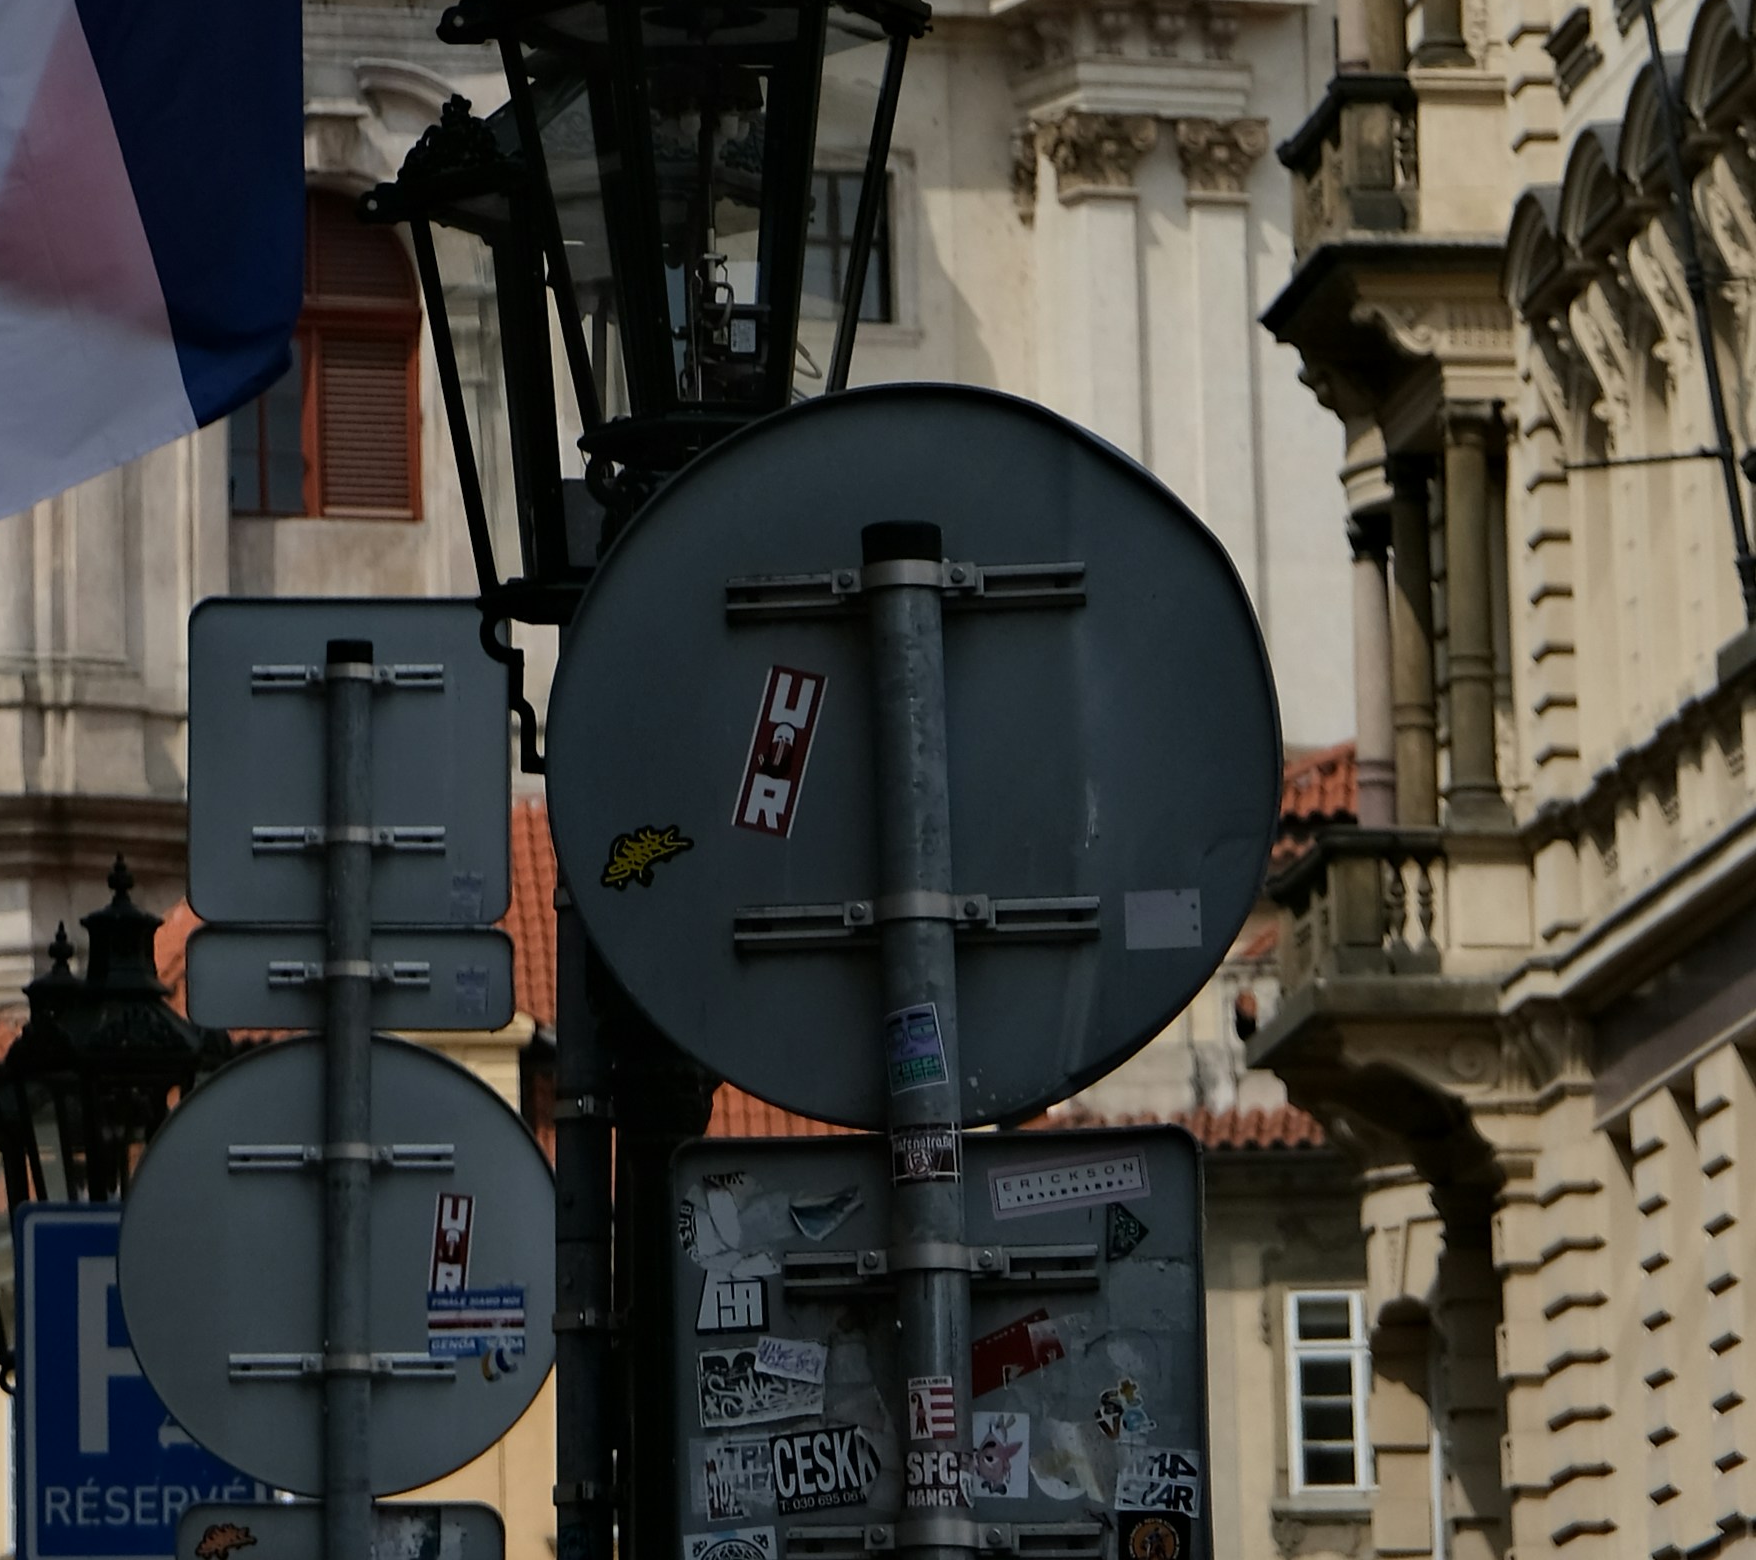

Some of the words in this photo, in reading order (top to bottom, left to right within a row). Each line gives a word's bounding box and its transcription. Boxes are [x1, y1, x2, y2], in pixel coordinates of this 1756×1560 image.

[1002, 1162, 1134, 1192] ERICKSON
[906, 1451, 958, 1485] SFC
[906, 1488, 958, 1507] NANCY
